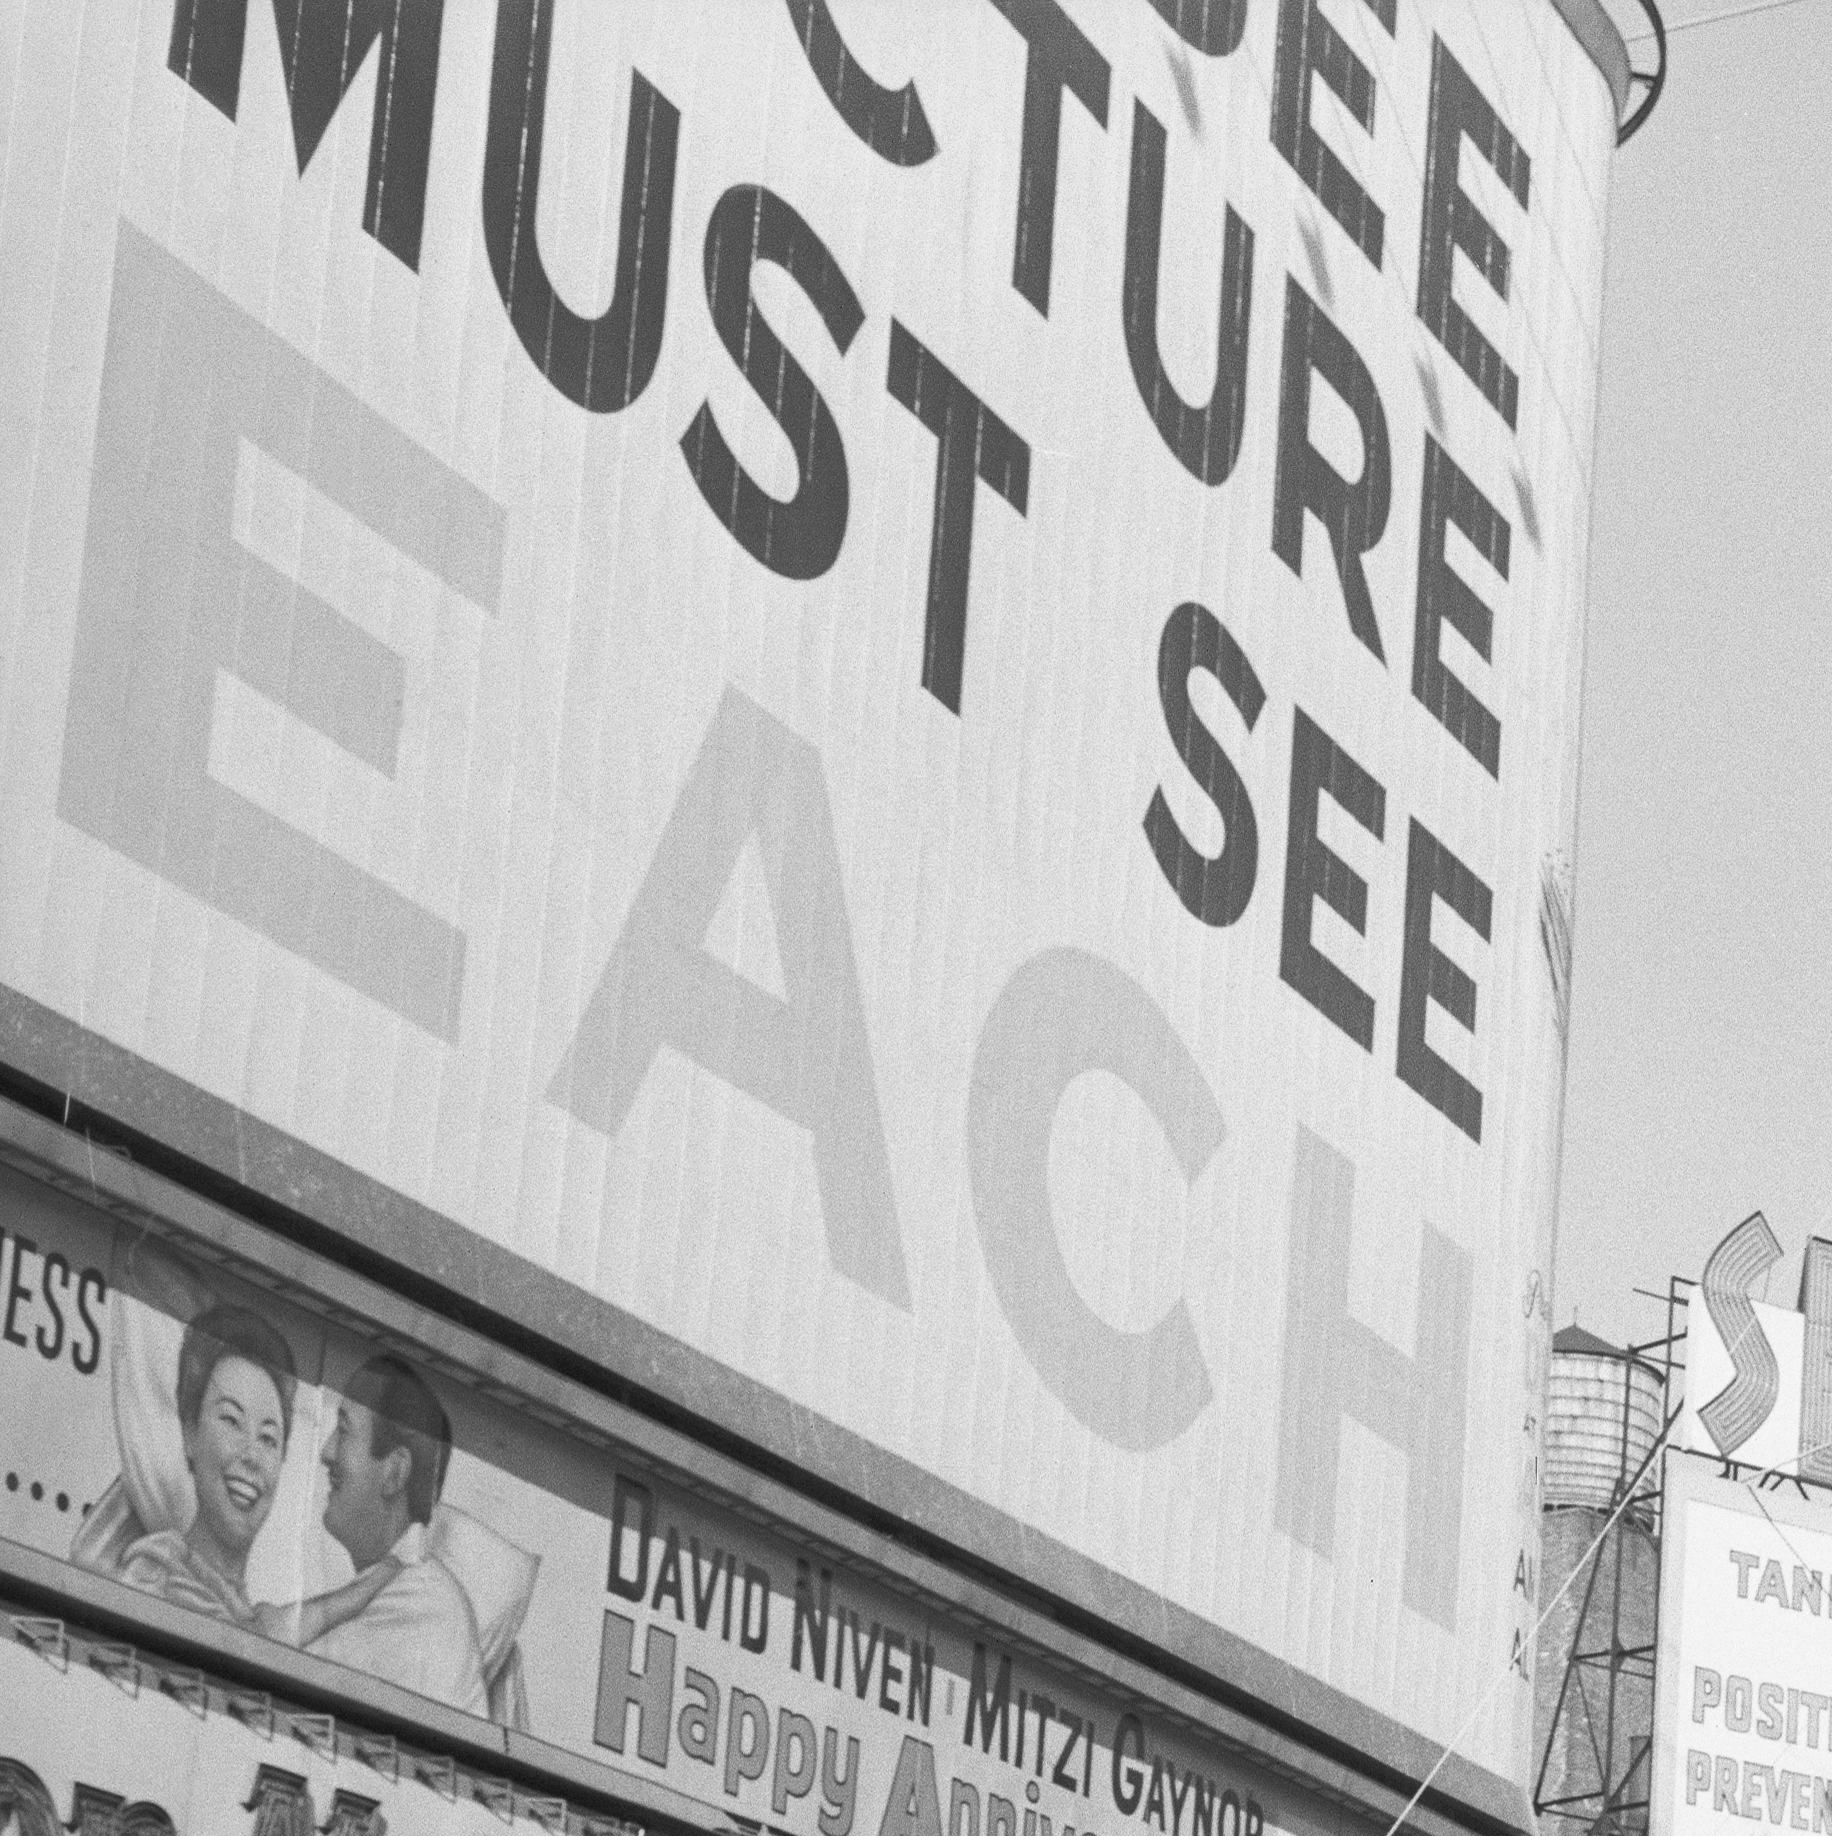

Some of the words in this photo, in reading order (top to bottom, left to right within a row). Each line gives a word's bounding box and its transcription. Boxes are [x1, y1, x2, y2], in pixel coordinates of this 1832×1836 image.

[1143, 0, 1532, 434] EE
[54, 212, 1476, 1636] EACH
[1142, 601, 1494, 1147] SEE
[0, 1228, 106, 1376] ESS
[606, 1472, 771, 1655] DAVID
[790, 1558, 936, 1728] NIVEN
[962, 1640, 1095, 1800] MITZI
